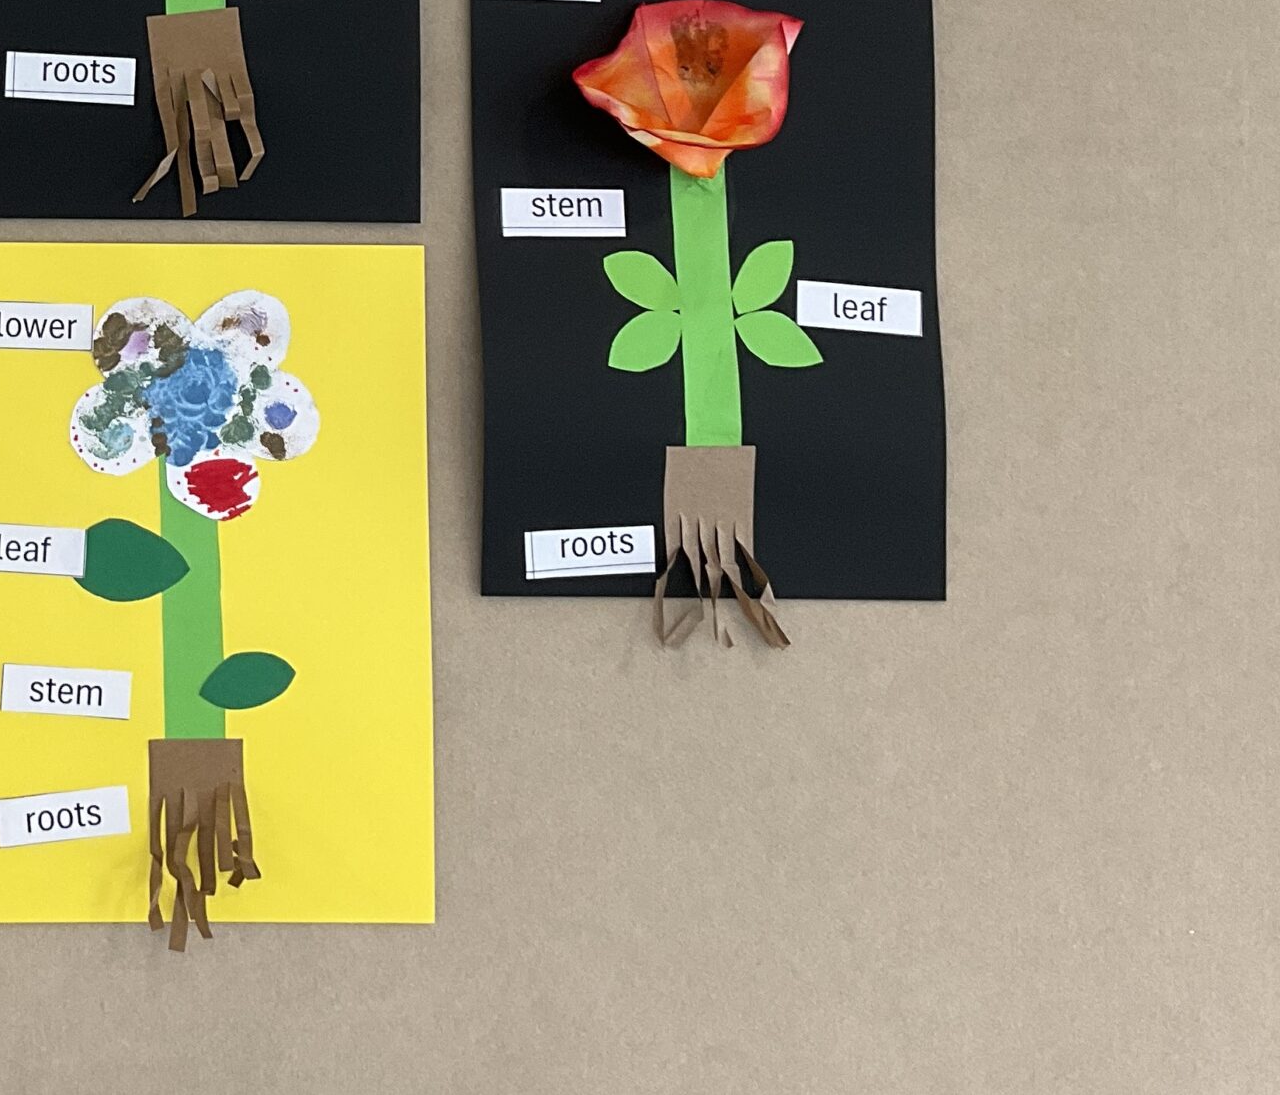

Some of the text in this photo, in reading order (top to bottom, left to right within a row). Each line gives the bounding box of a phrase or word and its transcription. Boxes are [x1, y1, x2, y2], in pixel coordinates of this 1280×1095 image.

[42, 59, 116, 83] roots
[532, 194, 603, 217] stem
[834, 294, 888, 321] leaf
[560, 532, 634, 557] roots
[30, 679, 103, 705] stem
[26, 803, 102, 832] roots
